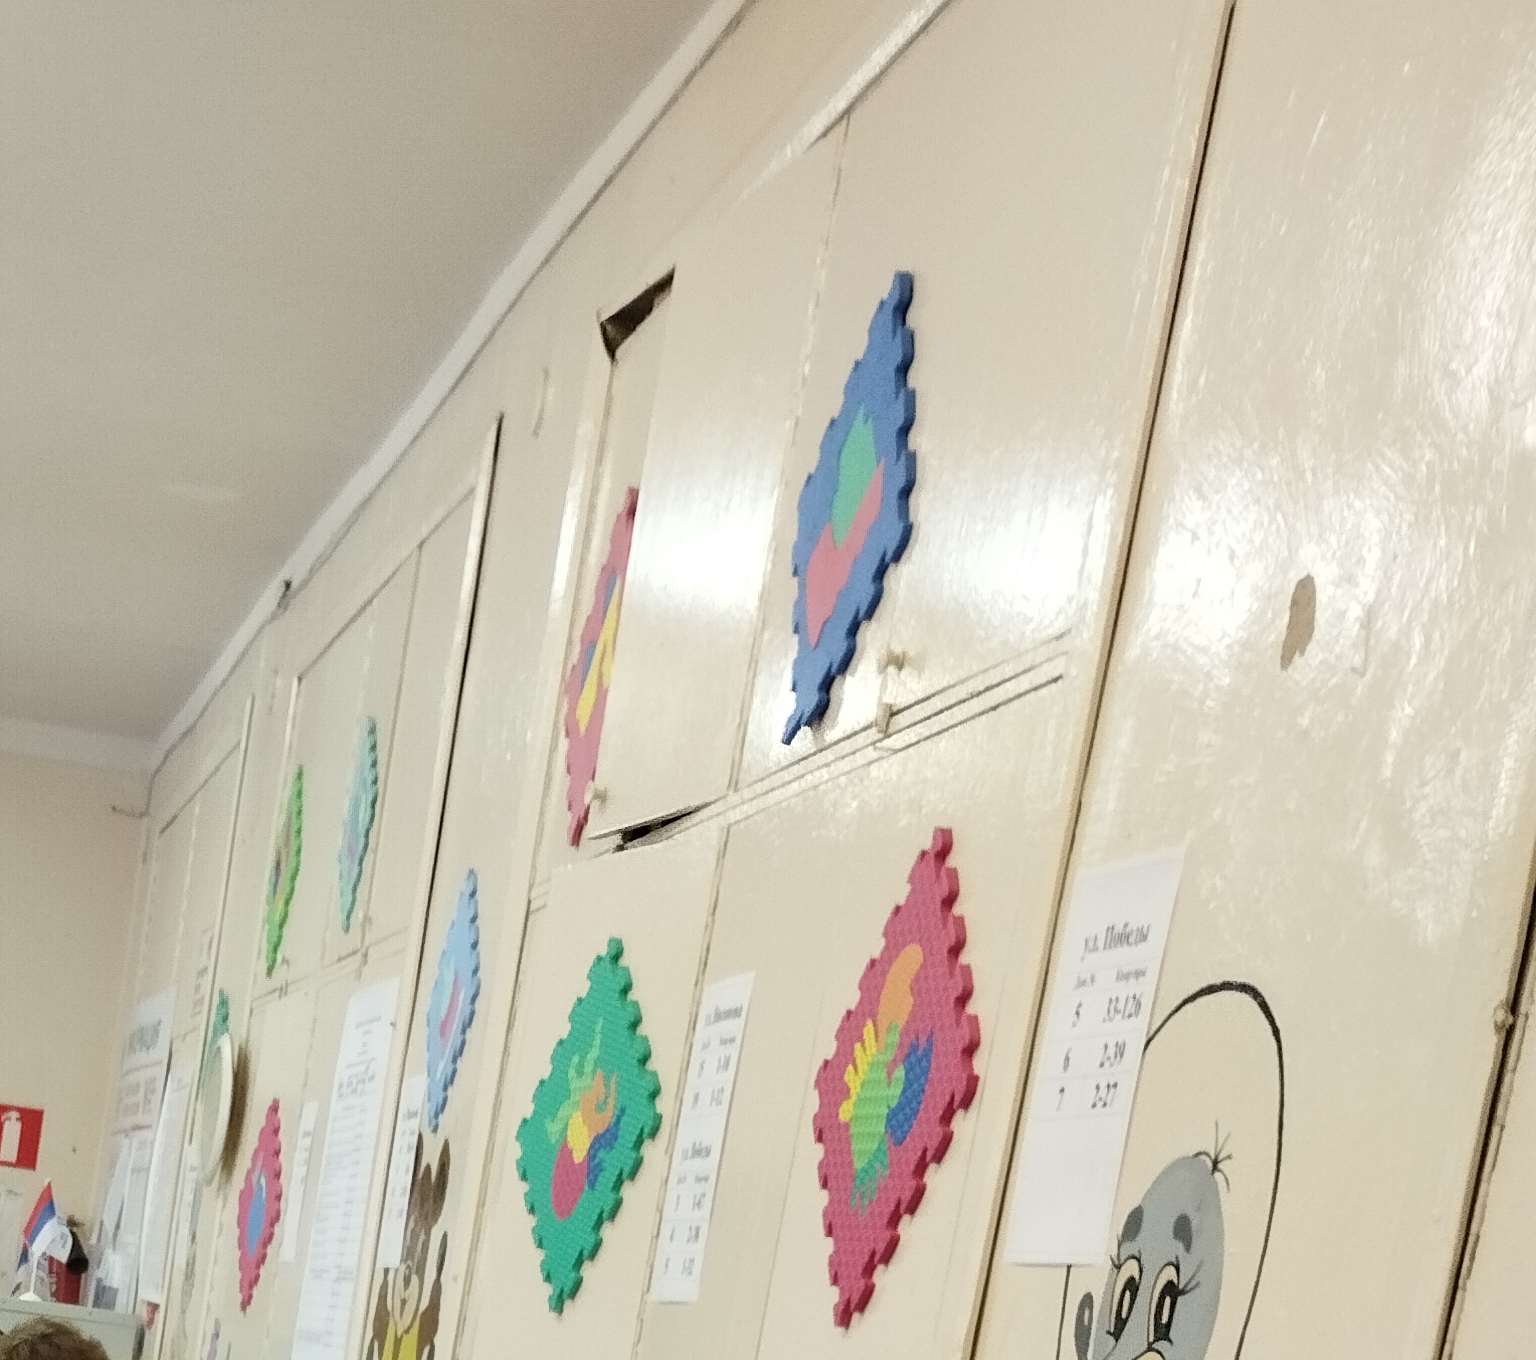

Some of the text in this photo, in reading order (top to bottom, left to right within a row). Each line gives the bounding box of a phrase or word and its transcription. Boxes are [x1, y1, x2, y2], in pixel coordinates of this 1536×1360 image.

[1103, 921, 1150, 950] Победы
[1063, 1046, 1073, 1073] 6
[1056, 1086, 1066, 1112] 7
